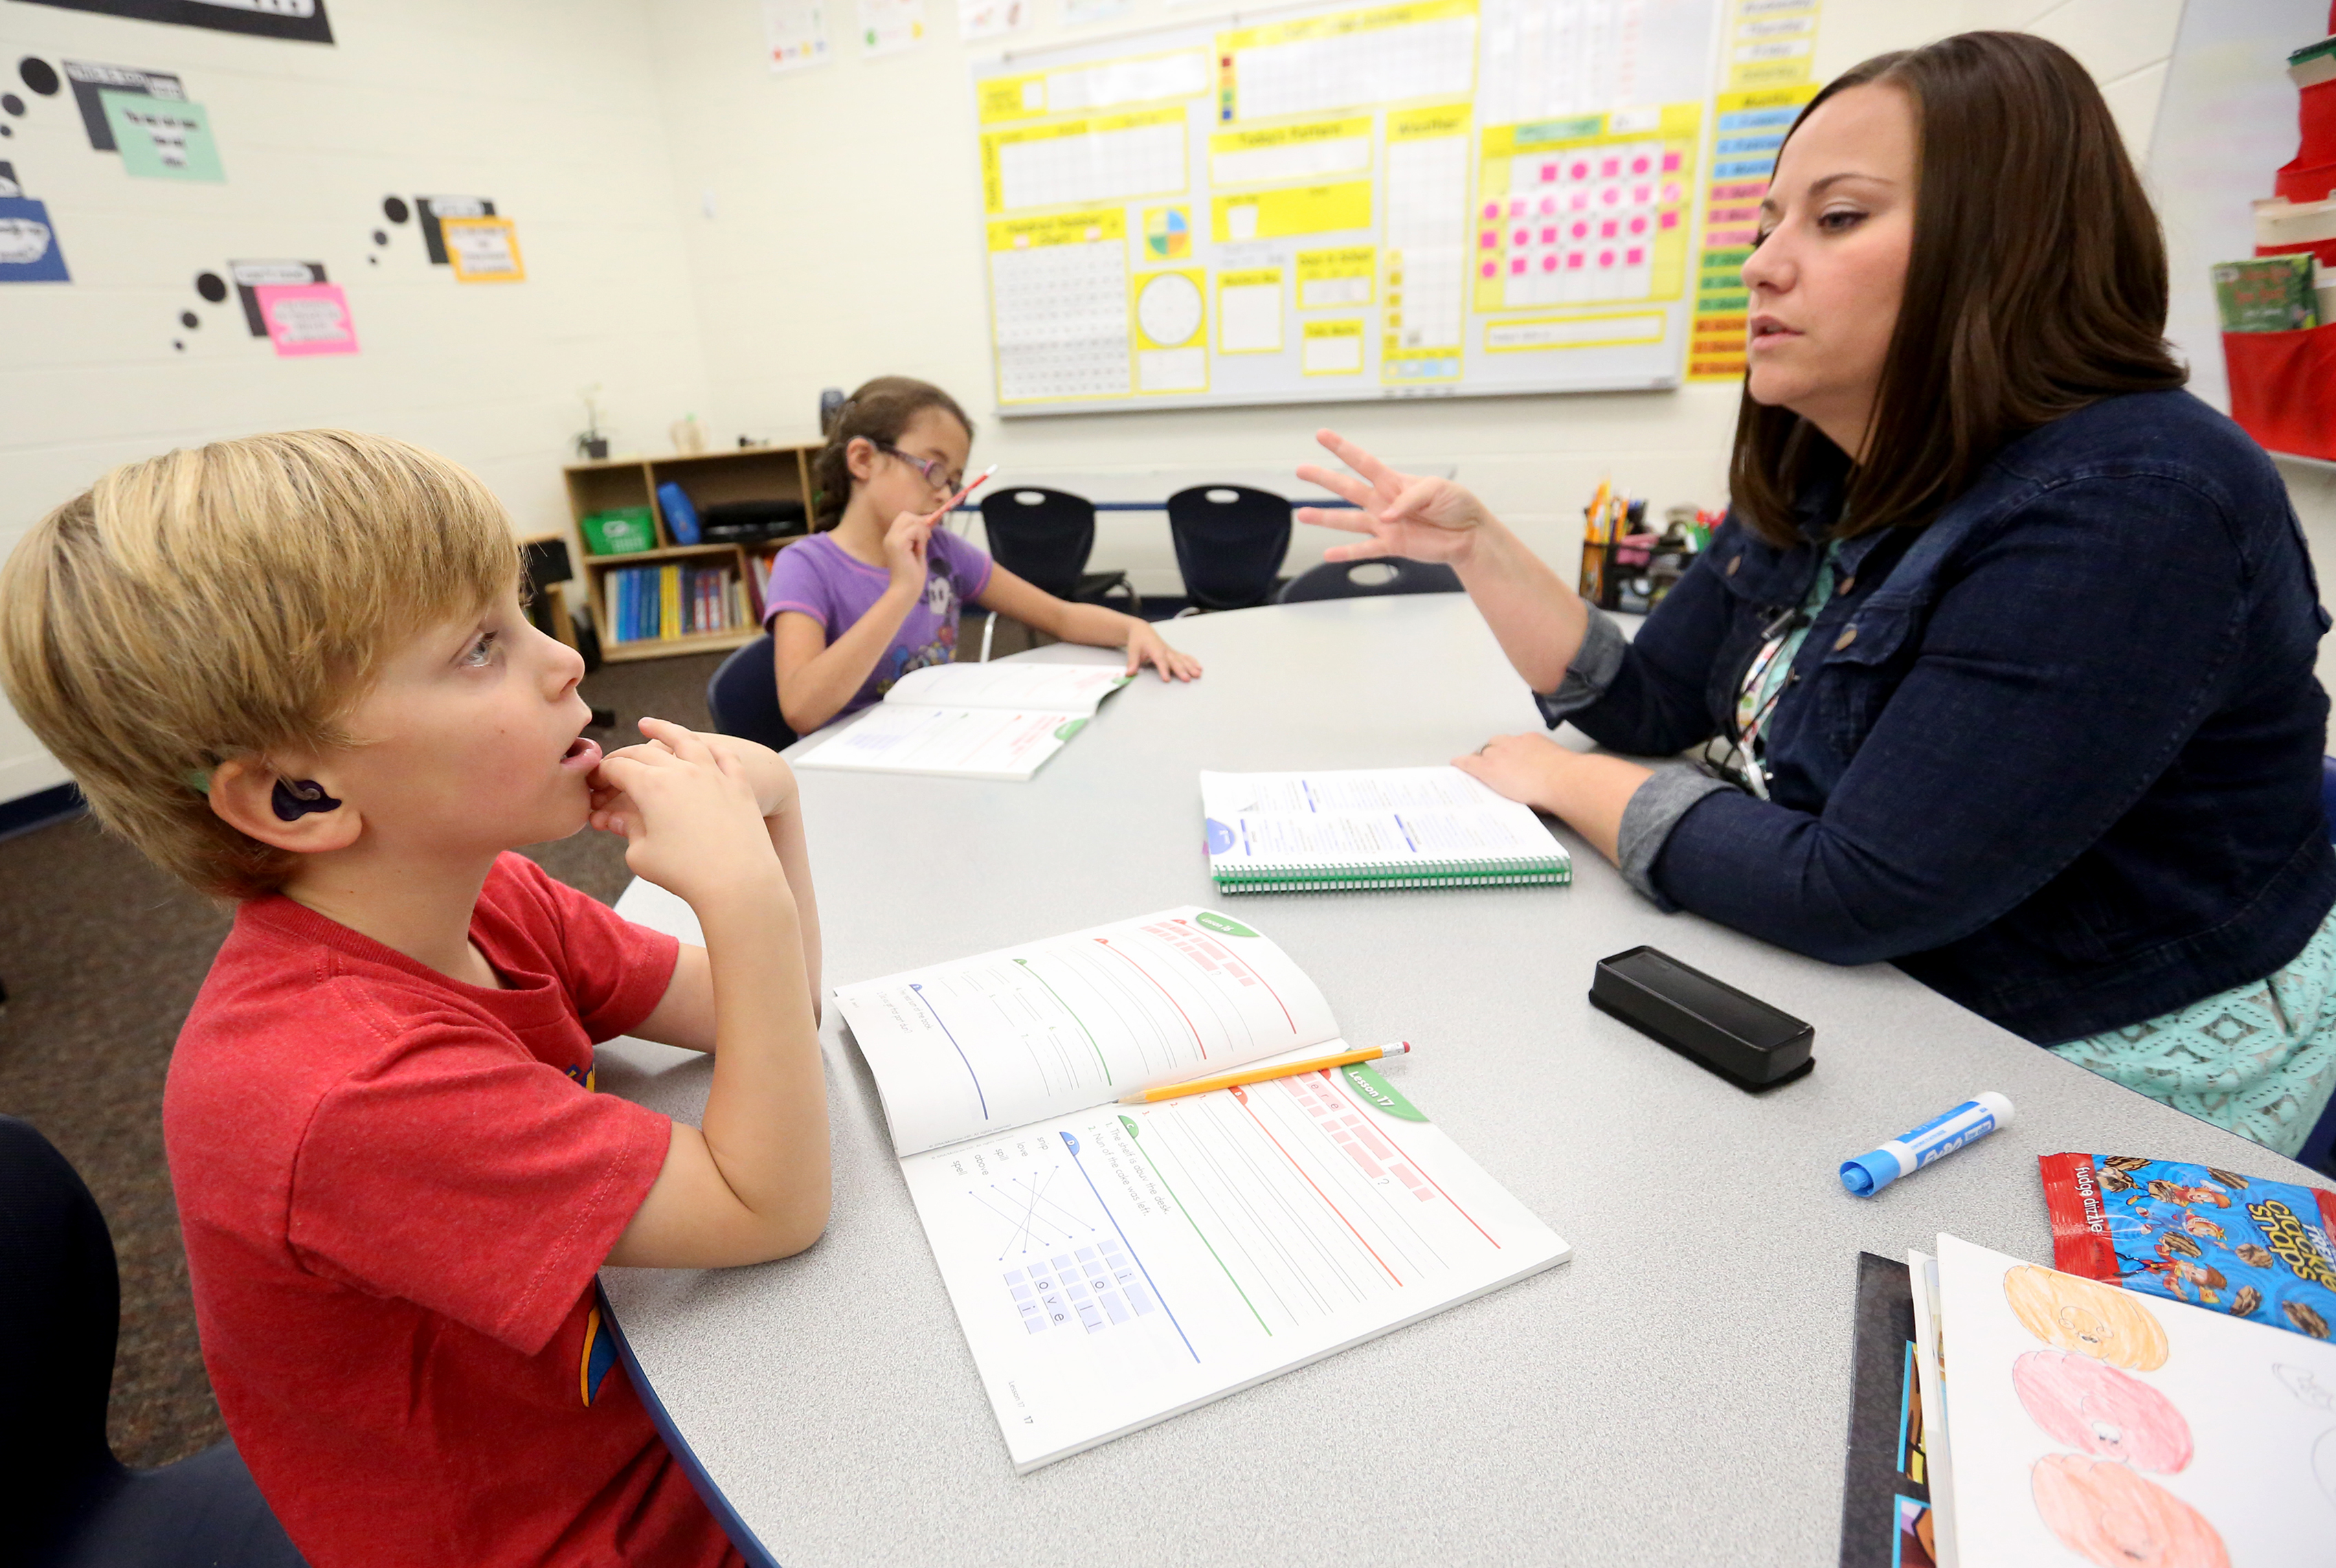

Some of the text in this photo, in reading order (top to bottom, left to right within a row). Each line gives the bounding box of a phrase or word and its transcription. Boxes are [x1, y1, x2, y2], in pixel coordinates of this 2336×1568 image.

[1348, 1071, 1395, 1107] Lesson 17
[993, 1148, 1010, 1161] spill
[1017, 1141, 1029, 1157] love
[1037, 1136, 1050, 1151] snip
[950, 1160, 968, 1176] spell
[974, 1154, 989, 1176] above
[1092, 1132, 1105, 1148] Nun
[1102, 1148, 1114, 1157] of
[1108, 1156, 1119, 1168] the
[1115, 1168, 1130, 1186] cake
[1127, 1185, 1141, 1202] was
[1136, 1200, 1152, 1217] left.
[1110, 1127, 1122, 1141] The
[1117, 1141, 1136, 1157] shelf
[1133, 1165, 1149, 1183] abuv
[1145, 1182, 1158, 1196] the
[1154, 1196, 1171, 1216] desk.
[1377, 1178, 1390, 1186] ?
[2074, 1166, 2095, 1197] fudge
[2083, 1198, 2104, 1233] drizzle
[2247, 1202, 2317, 1281] snaps
[2265, 1199, 2336, 1293] crackle
[1008, 1380, 1020, 1401] Lesson
[1023, 1415, 1034, 1424] 17
